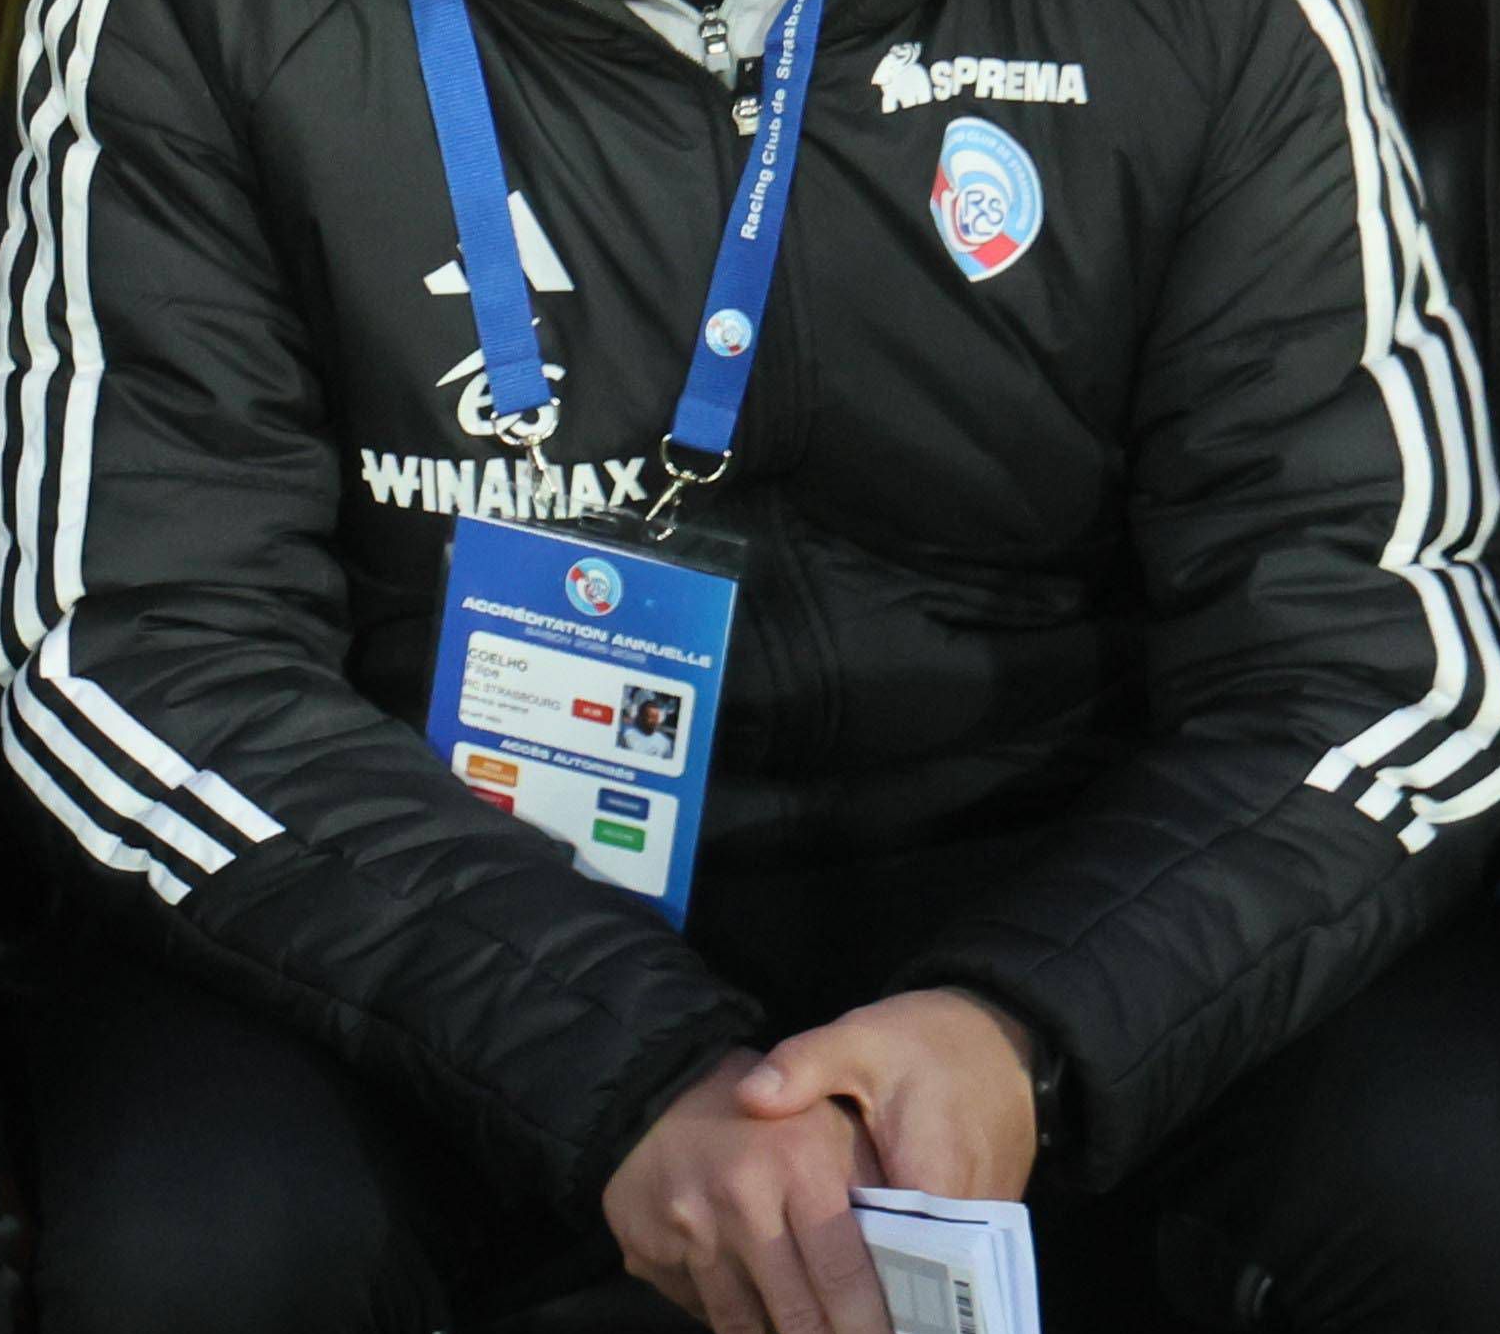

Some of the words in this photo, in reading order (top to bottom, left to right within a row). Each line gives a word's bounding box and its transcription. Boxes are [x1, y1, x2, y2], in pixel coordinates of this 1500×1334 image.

[740, 170, 775, 241] Racing
[762, 117, 782, 165] Club
[772, 88, 787, 115] de
[360, 448, 647, 520] WINAMAX
[468, 647, 528, 673] COELHO
[611, 632, 713, 670] ANNUELLE
